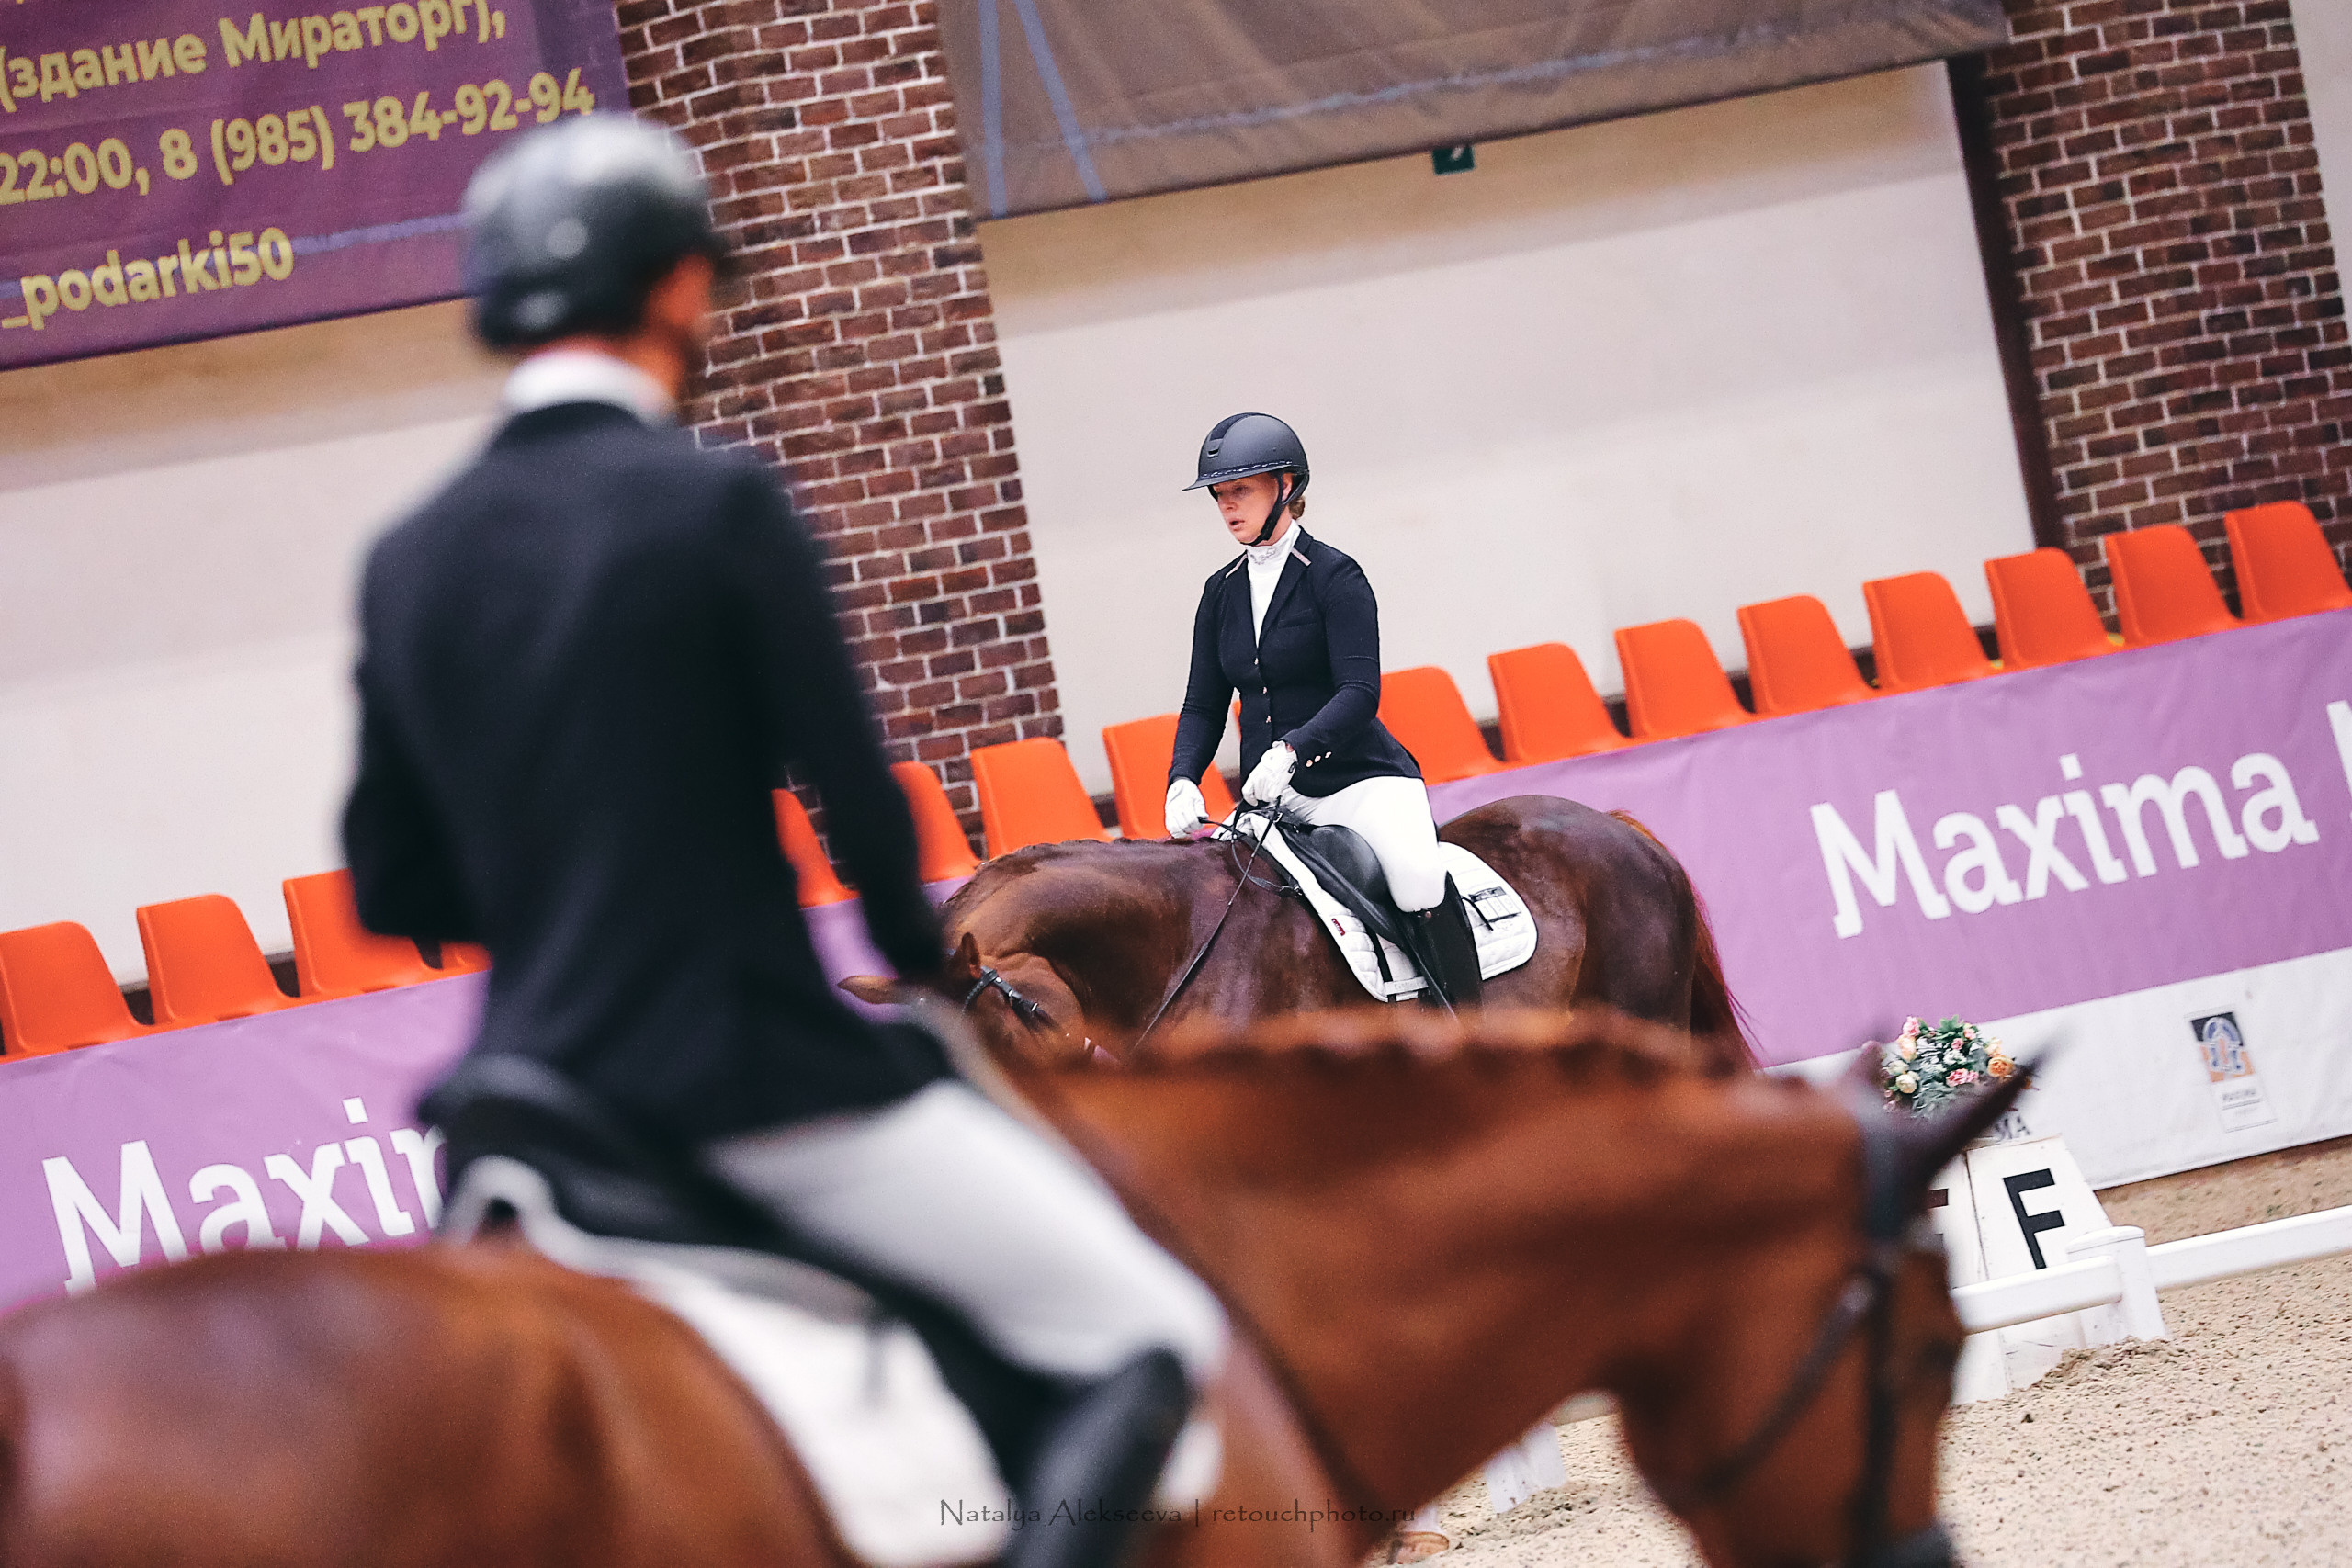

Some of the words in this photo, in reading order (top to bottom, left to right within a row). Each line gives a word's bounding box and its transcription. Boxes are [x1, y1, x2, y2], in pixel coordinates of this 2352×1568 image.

[0, 33, 207, 112] (здание
[218, 0, 506, 69] Мираторг),
[0, 137, 151, 206] 22:00,
[158, 128, 198, 180] 8
[210, 105, 335, 186] (985)
[341, 67, 595, 153] 384-92-94
[1, 227, 294, 331] _podarki50
[1809, 752, 2321, 939] Maxima
[2003, 1168, 2066, 1270] F
[940, 1498, 1041, 1531] Natalya
[1048, 1498, 1182, 1526] Alekseeva
[1212, 1498, 1417, 1532] retouchphoto.ru
